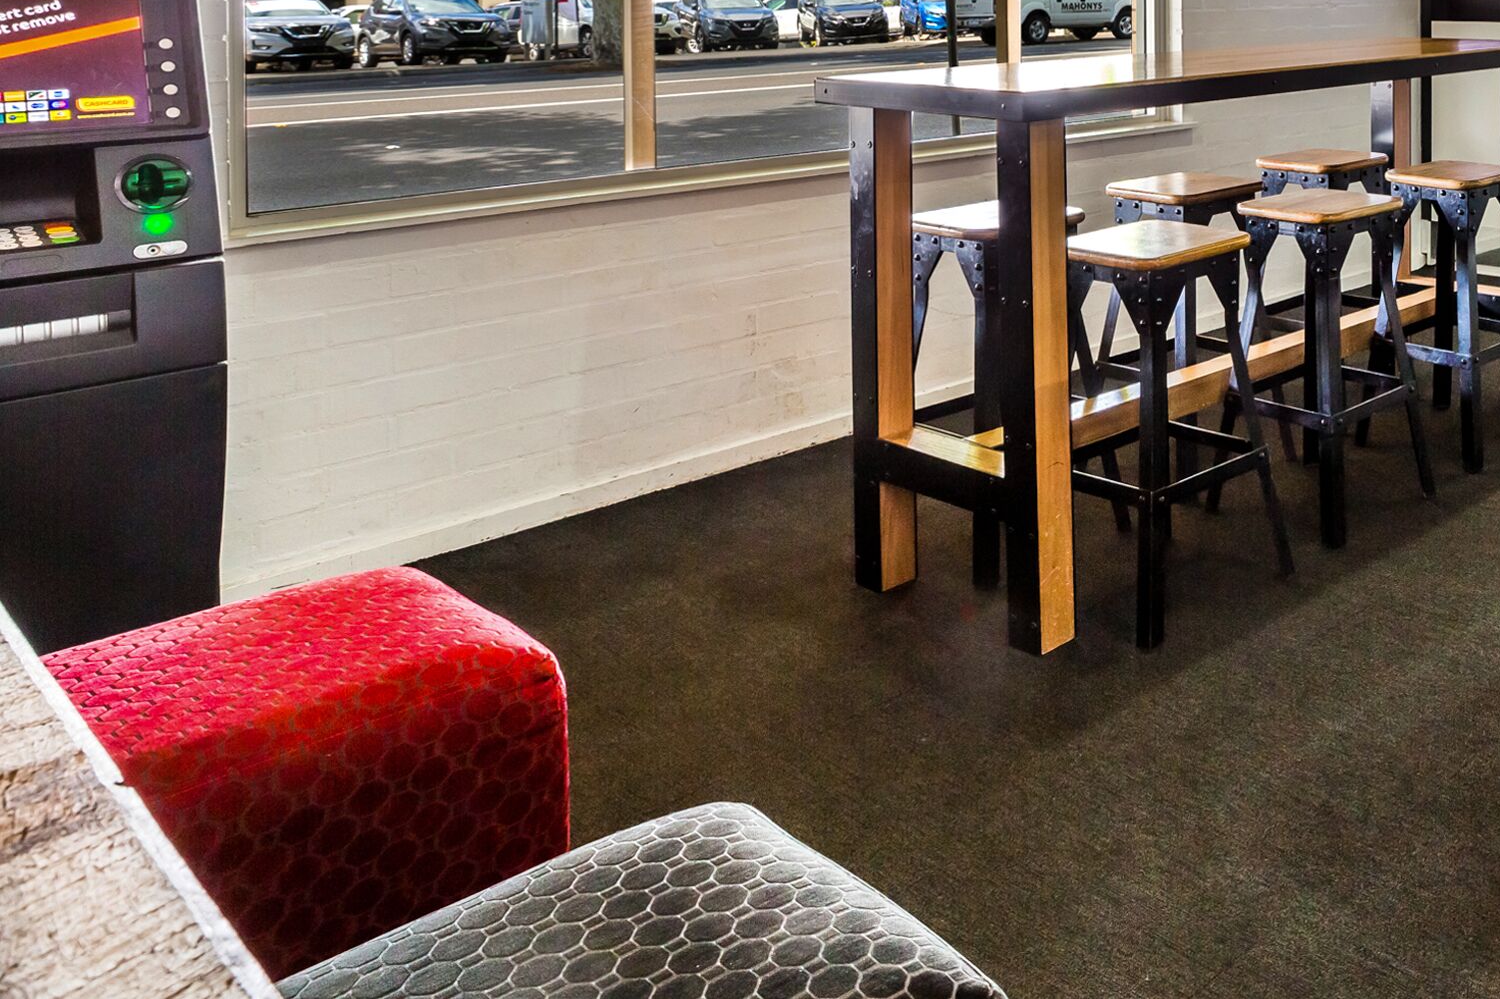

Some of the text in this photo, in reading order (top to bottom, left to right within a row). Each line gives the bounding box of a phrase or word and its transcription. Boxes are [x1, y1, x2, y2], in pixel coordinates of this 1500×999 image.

[24, 0, 62, 16] card
[1061, 2, 1102, 10] MAHONYS
[0, 11, 76, 35] t remove
[84, 99, 128, 107] CASHCARD
